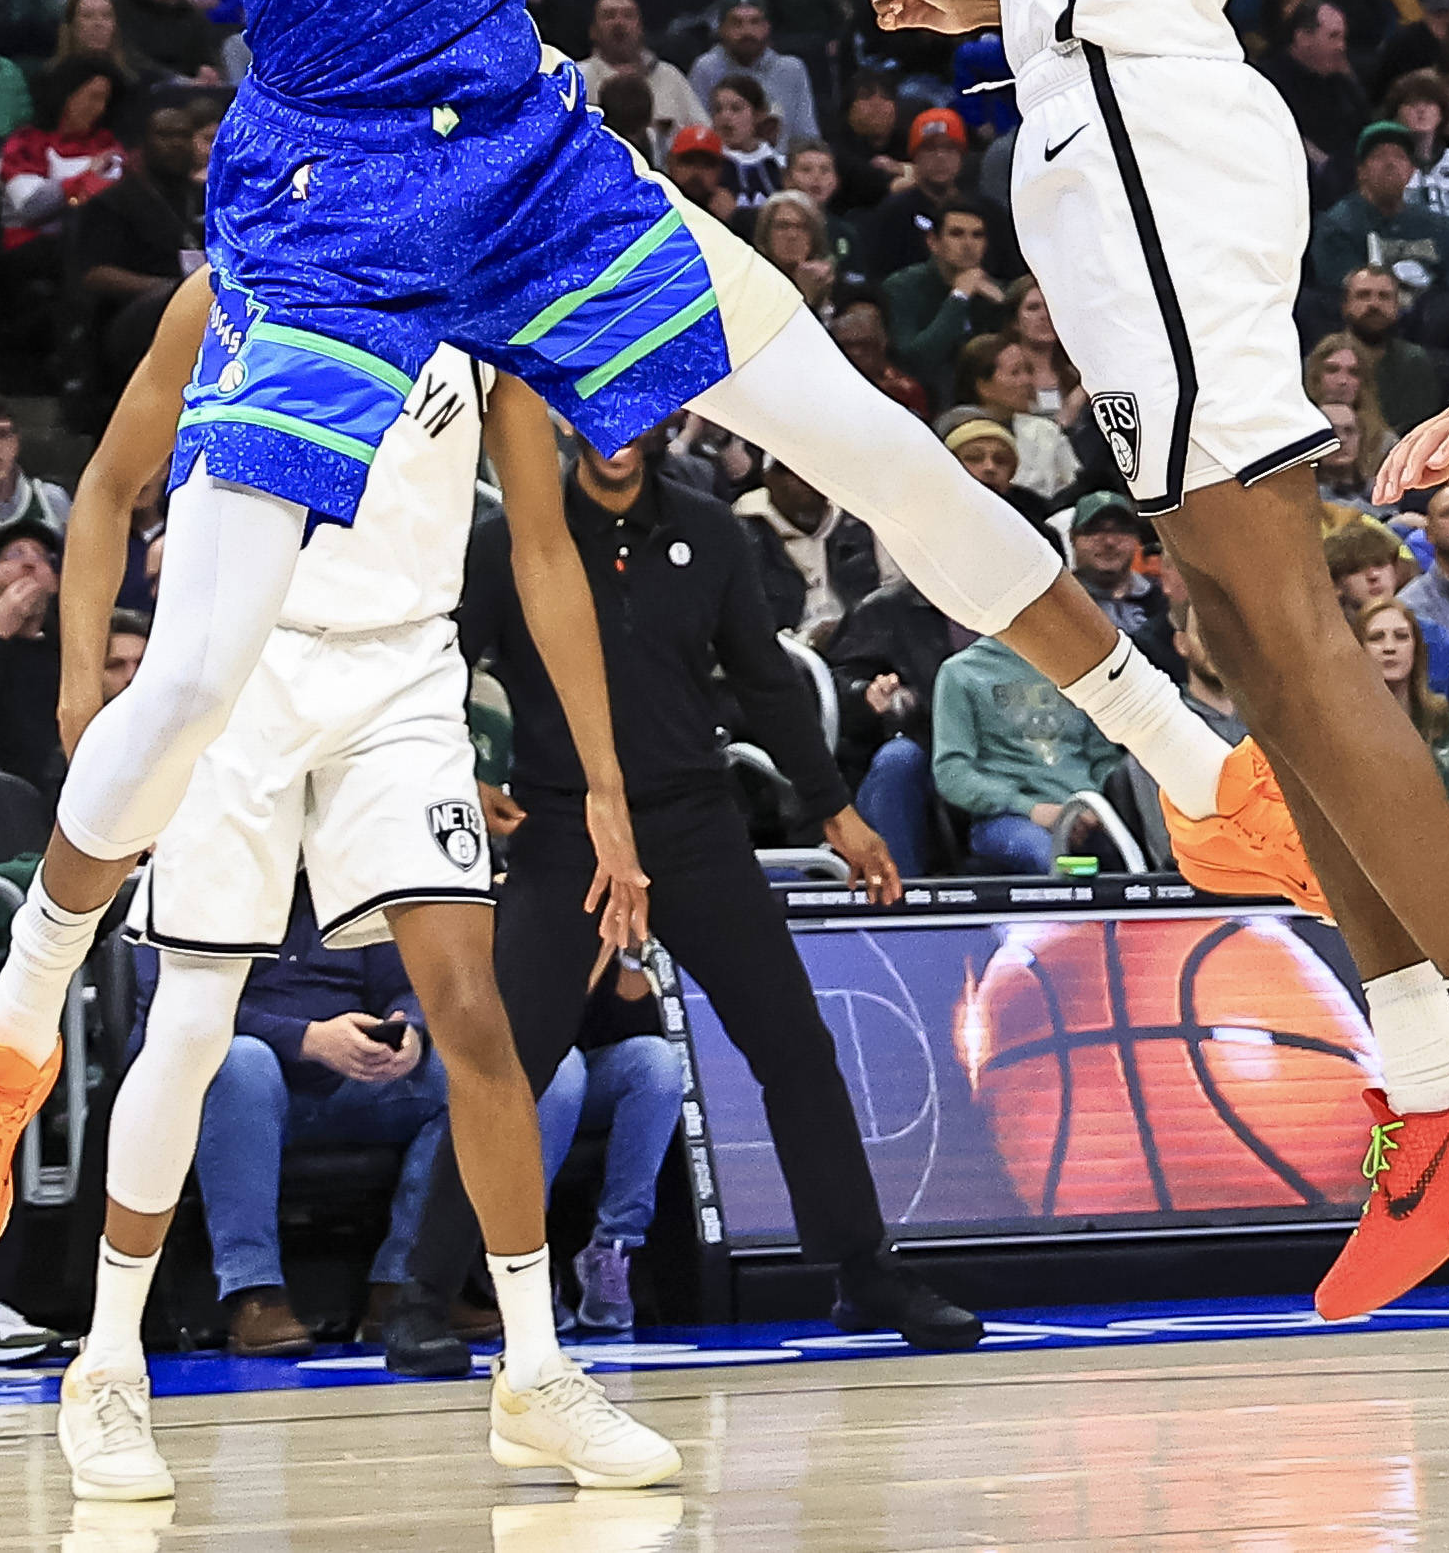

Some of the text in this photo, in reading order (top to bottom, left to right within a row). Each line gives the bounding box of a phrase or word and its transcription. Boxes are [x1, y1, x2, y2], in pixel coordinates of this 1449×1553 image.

[209, 300, 243, 355] UCKS
[403, 372, 465, 439] YN
[1093, 398, 1136, 431] ETS
[431, 803, 481, 836] NETS
